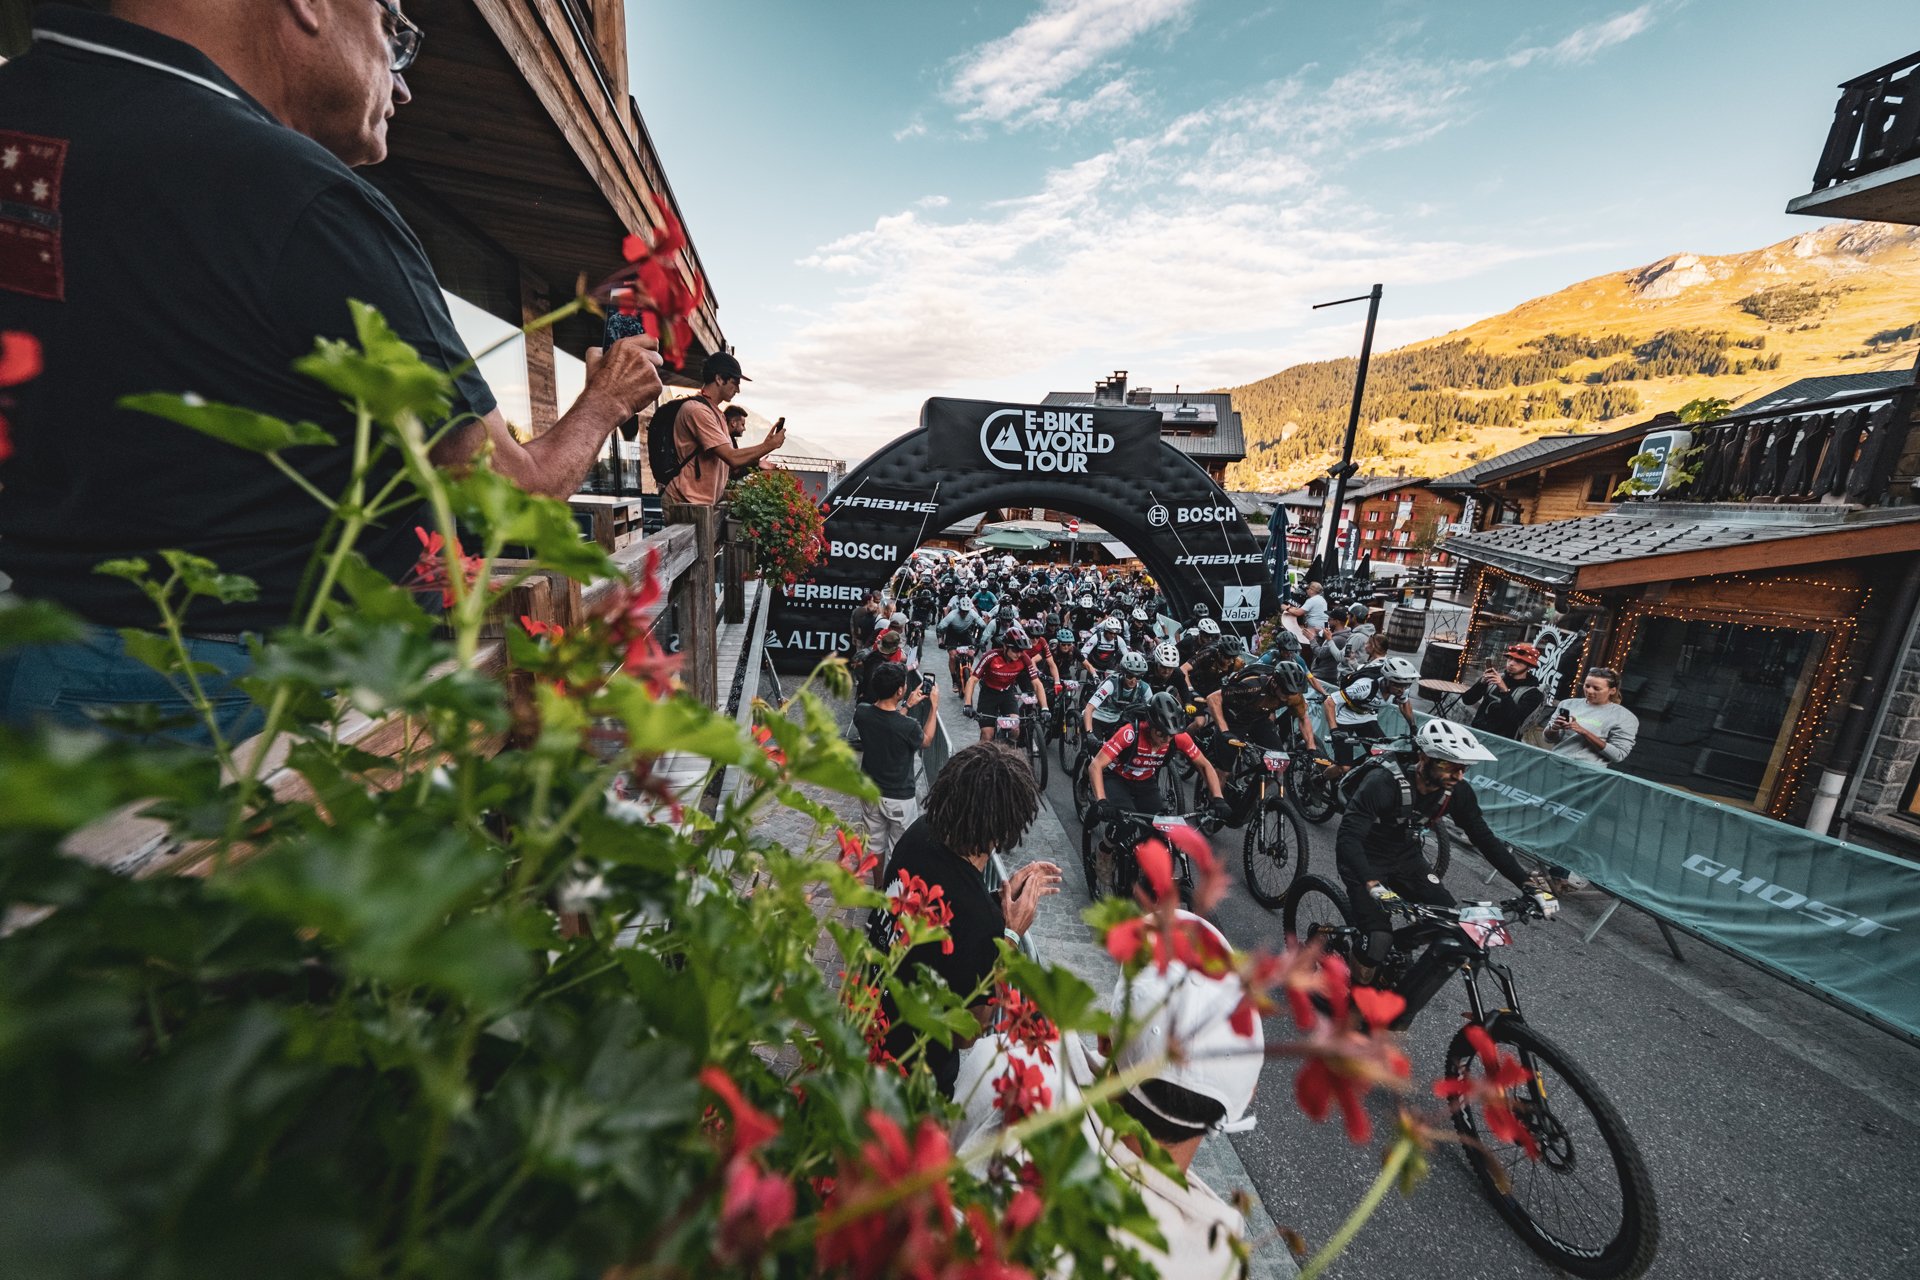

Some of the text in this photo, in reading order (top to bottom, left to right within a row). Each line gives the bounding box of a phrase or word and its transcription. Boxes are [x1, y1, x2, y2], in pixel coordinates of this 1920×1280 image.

[1024, 409, 1094, 433] E-BIKE
[1024, 430, 1115, 454] WORLD
[1024, 450, 1089, 473] TOUR
[832, 495, 940, 514] HAIBIKE
[1177, 506, 1238, 523] BOSCH
[830, 540, 898, 562] BOSCH
[1174, 553, 1263, 566] HAIBIKE
[782, 583, 863, 601] VERBIER
[1224, 607, 1257, 620] Valais
[786, 630, 851, 652] ALTIS
[1466, 774, 1588, 824] APIERRE
[1681, 854, 1901, 937] GHOST
